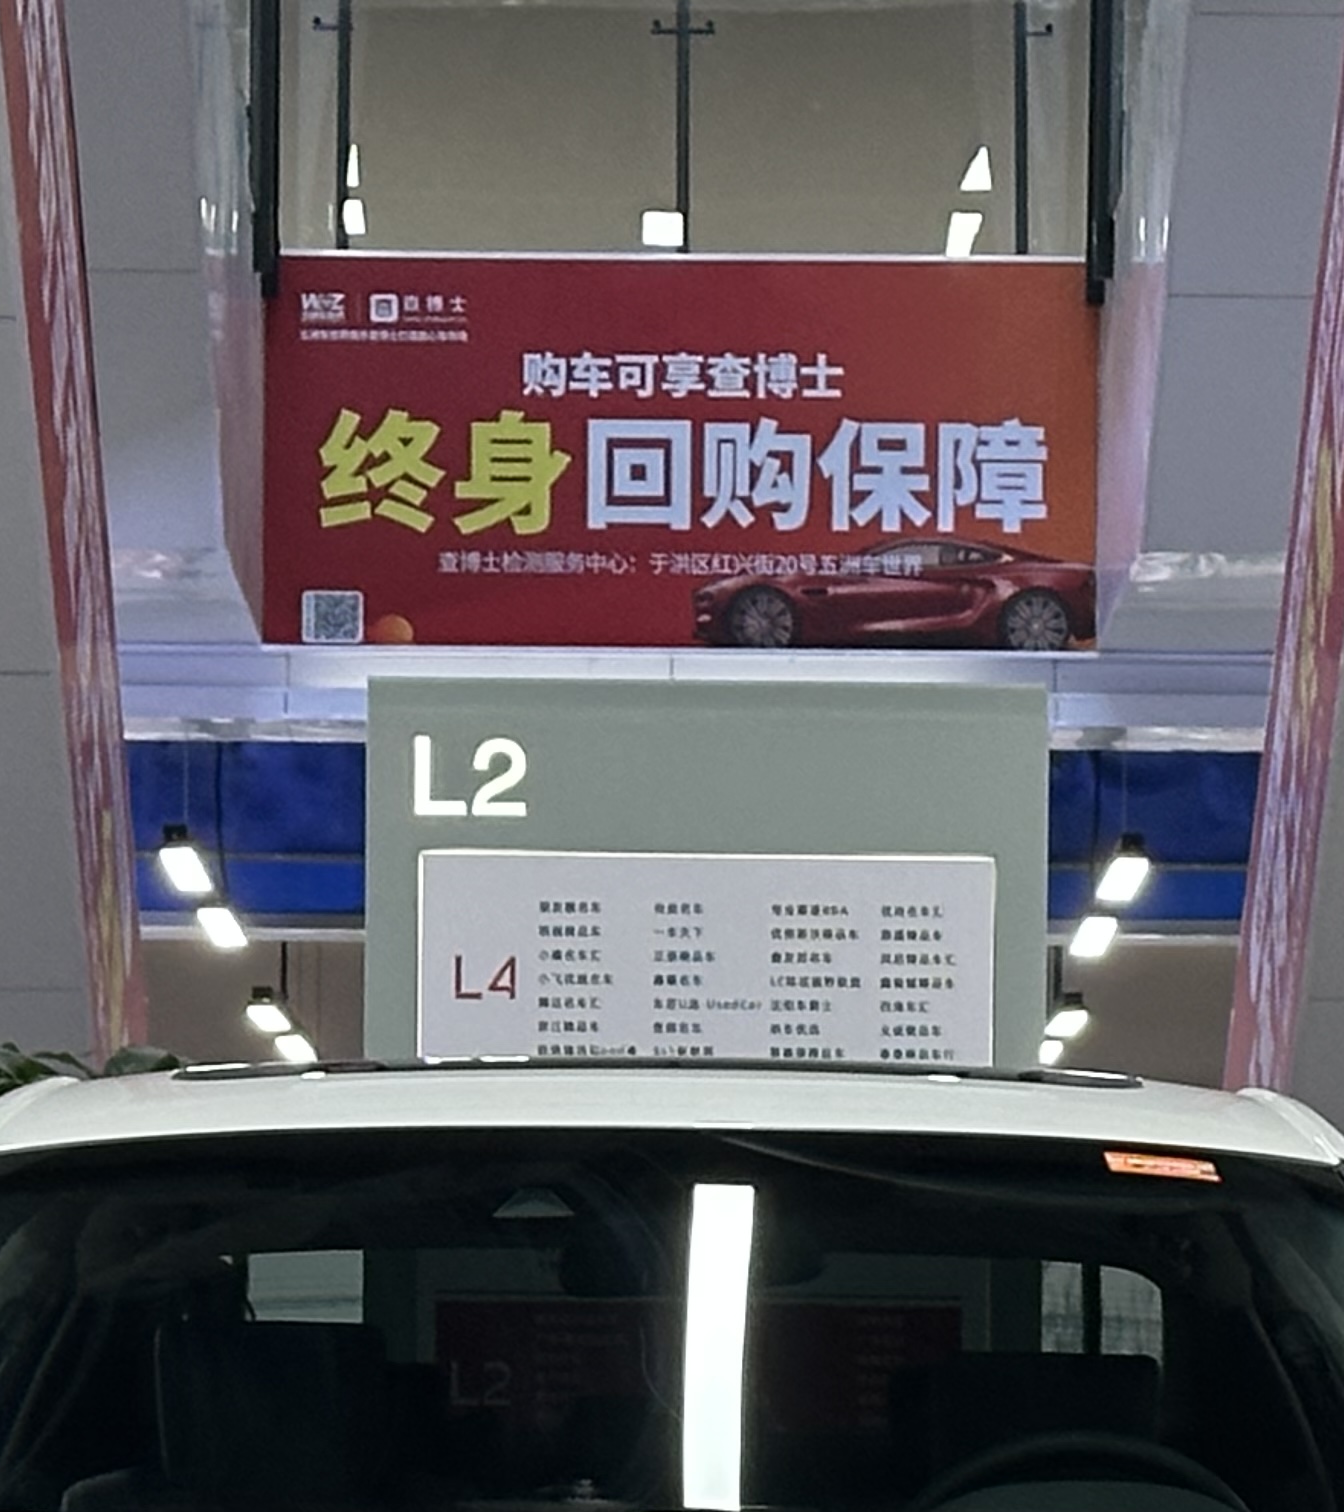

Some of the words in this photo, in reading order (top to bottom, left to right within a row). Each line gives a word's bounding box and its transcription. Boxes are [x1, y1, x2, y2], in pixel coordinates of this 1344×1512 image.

[523, 352, 846, 399] 购车可享查博士
[319, 409, 1048, 536] 终身回购保障
[413, 735, 528, 816] L2
[454, 955, 517, 999] L4
